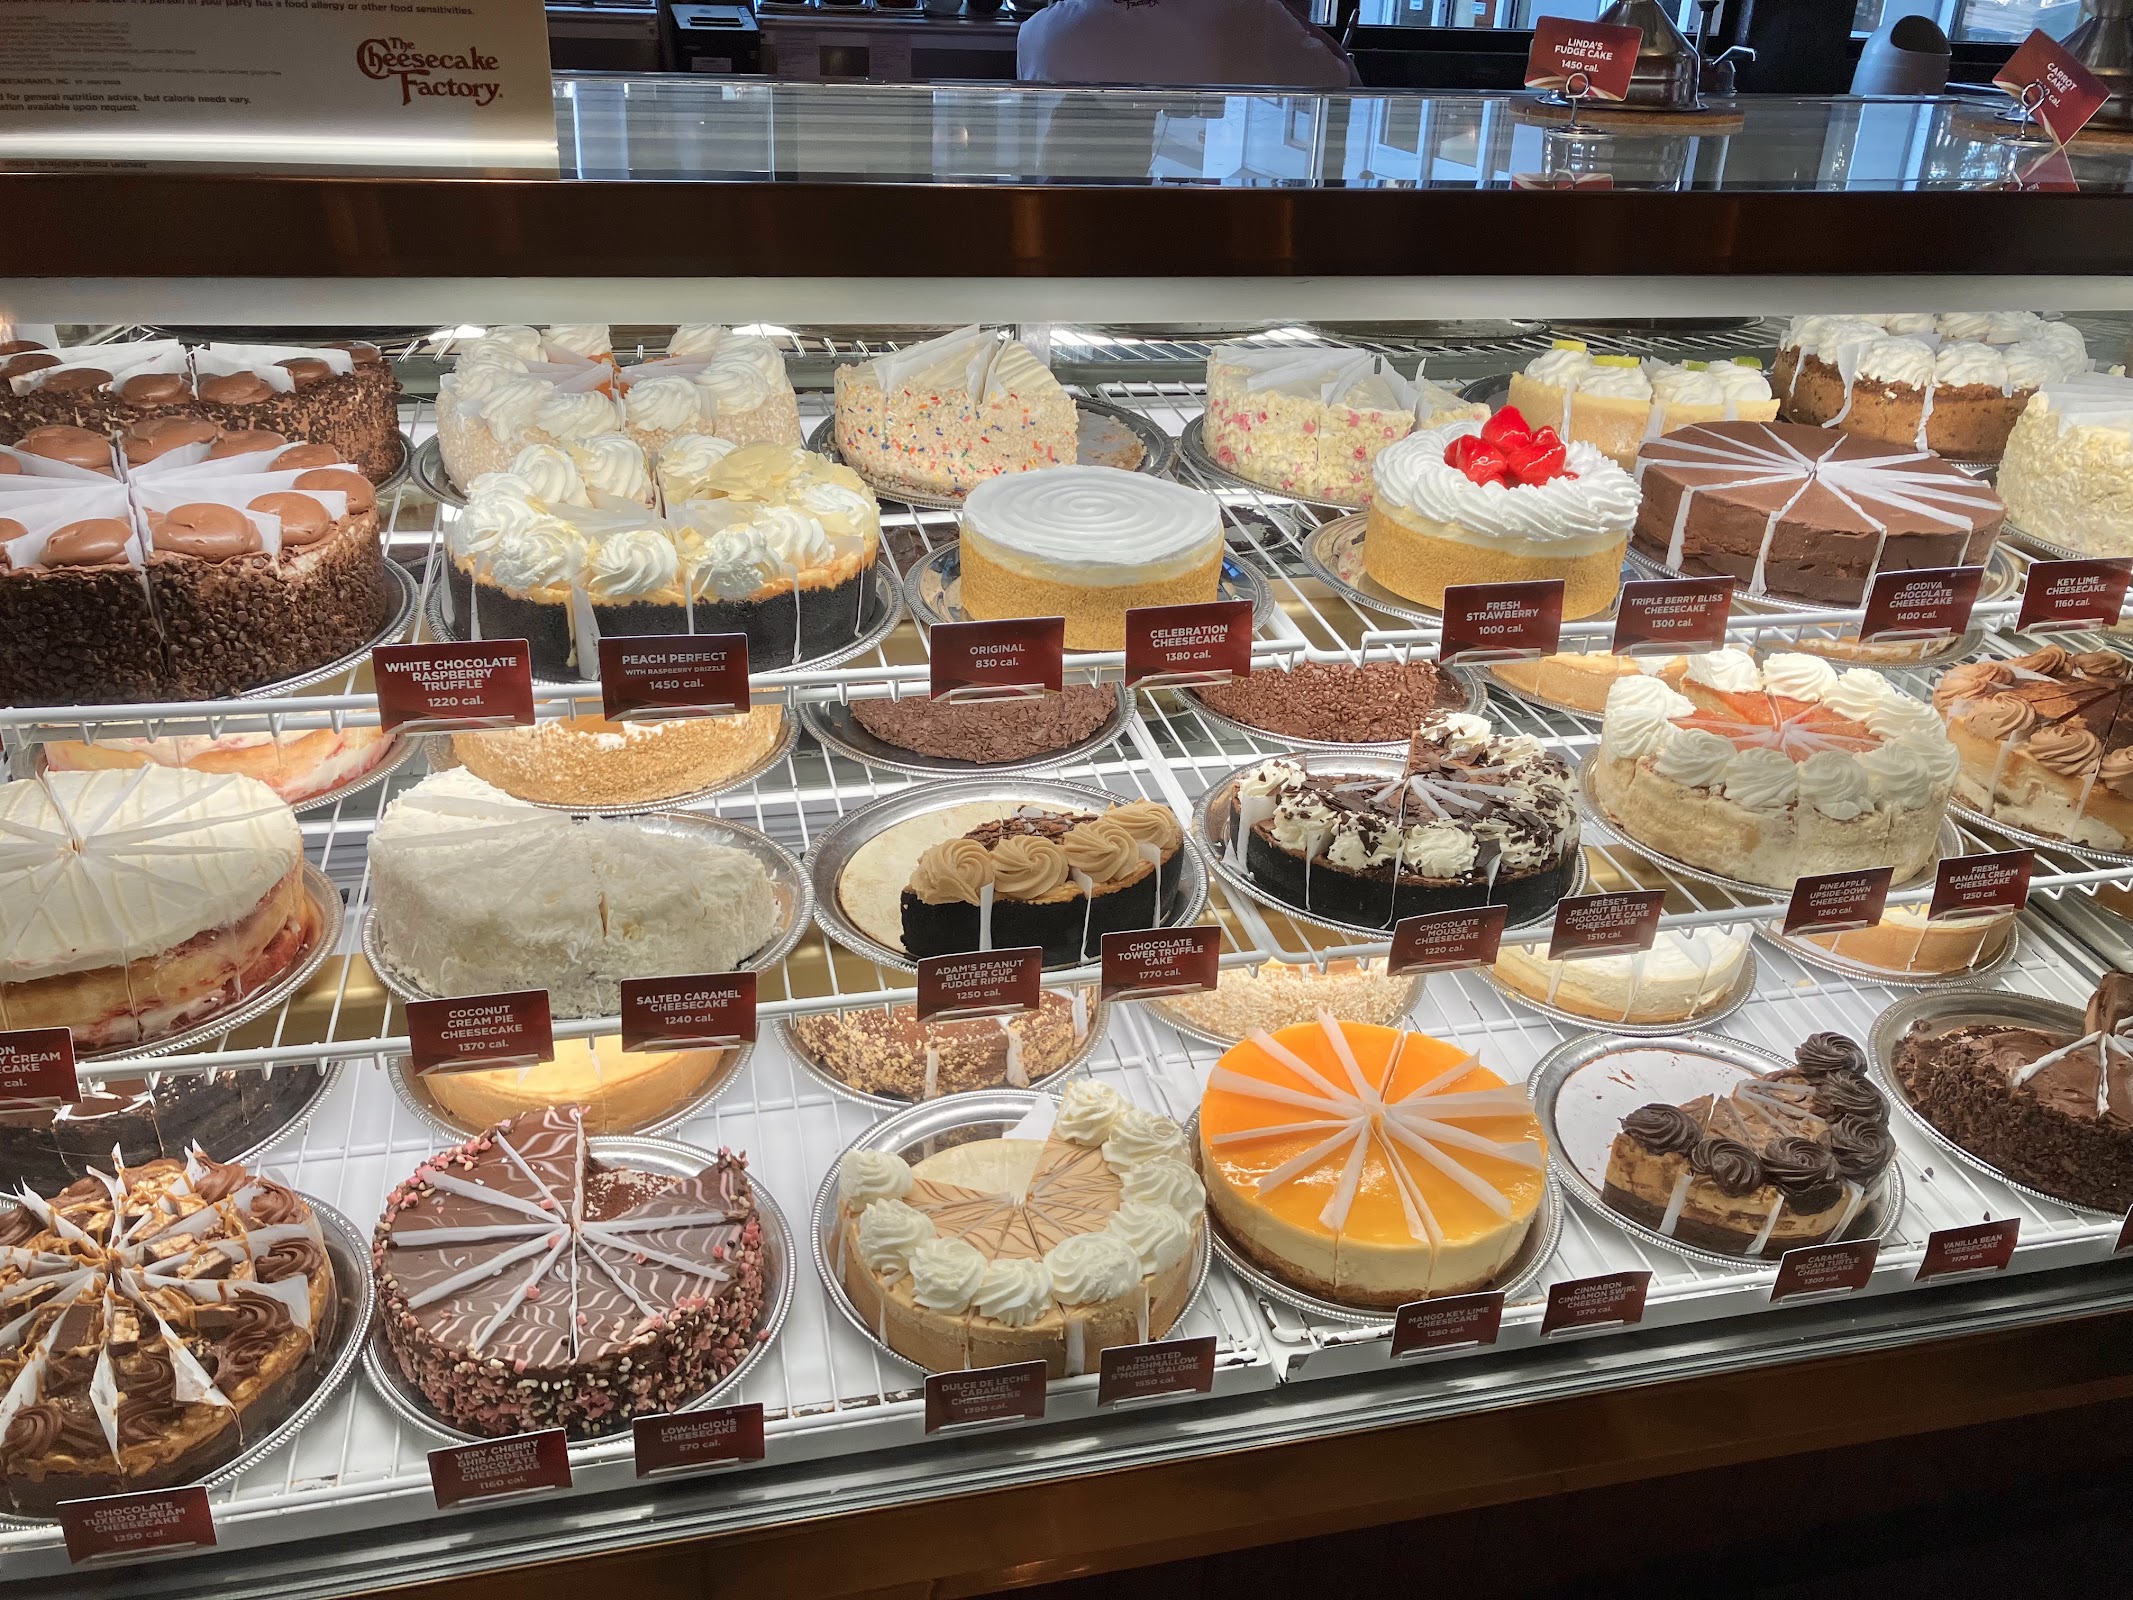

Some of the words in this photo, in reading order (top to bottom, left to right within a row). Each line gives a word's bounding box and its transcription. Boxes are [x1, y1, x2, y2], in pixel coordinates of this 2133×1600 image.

[285, 0, 309, 9] food
[311, 2, 345, 12] allergy
[361, 3, 387, 12] other
[390, 4, 414, 13] food
[416, 6, 475, 16] sensitivities.
[389, 37, 416, 53] The
[1567, 38, 1603, 51] LINDA'S
[357, 38, 500, 79] Cheesecake
[1555, 45, 1586, 57] FUDGE
[1588, 50, 1612, 61] CAKE
[1561, 59, 1582, 69] 1450
[1584, 63, 1599, 72] cal.
[2047, 62, 2077, 91] CARROT
[2046, 73, 2067, 94] CAKE
[24, 94, 60, 102] general
[63, 93, 104, 101] nutrition
[144, 94, 160, 102] but
[163, 94, 195, 103] calorie
[229, 97, 251, 105] vary.
[2048, 94, 2061, 107] cal.
[28, 103, 70, 111] available
[100, 104, 140, 112] request.
[1906, 581, 1943, 591] GODIVA
[2057, 577, 2074, 586] KEY
[2077, 576, 2100, 584] LIME
[1894, 589, 1952, 599] CHOCOLATE
[2046, 584, 2106, 595] CHEESECAKE
[1487, 601, 1521, 610] FRESH
[1631, 597, 1662, 606] TRIPLE
[1664, 595, 1695, 604] BERRY
[1698, 594, 1723, 603] BLISS
[1889, 597, 1953, 608] CHEESECAKE
[2074, 598, 2090, 607] cal.
[1466, 609, 1539, 621] STRAWBERRY
[1644, 604, 1706, 614] CHEESECAKE
[1897, 612, 1919, 621] 1400
[1922, 611, 1937, 619] cal.
[1652, 619, 1676, 628] 1300
[1678, 618, 1693, 627] cal.
[1150, 625, 1228, 639] CELEBRATION
[1479, 626, 1504, 635] 1000
[1507, 624, 1524, 633] cal.
[1153, 634, 1225, 648] CHEESECAKE
[970, 643, 1025, 655] ORIGINAL
[622, 654, 666, 664] PEACH
[670, 652, 727, 663] PERFECT
[1166, 652, 1190, 661] 1380
[1193, 650, 1211, 660] cal.
[386, 661, 431, 673] WHITE
[435, 657, 517, 670] CHOCOLATE
[976, 658, 997, 668] 830
[1000, 657, 1019, 667] cal.
[412, 669, 492, 681] RASPBERRY
[647, 667, 692, 675] RASPBERRY
[694, 665, 726, 673] DRIZZLE
[422, 679, 483, 692] TRUFFLE
[650, 680, 679, 690] 1450
[683, 678, 704, 688] cal.
[427, 697, 458, 707] 1220
[462, 695, 484, 706] cal.
[1971, 864, 1999, 873] FRESH
[1950, 873, 1986, 884] BANANA
[1989, 869, 2018, 879] CREAM
[1819, 879, 1866, 890] PINEAPPLE
[1955, 877, 2011, 890] CHEESECAKE
[1810, 886, 1871, 899] UPSIDE-DOWN
[1962, 891, 1981, 900] 1250
[1983, 889, 1997, 898] cal.
[1590, 897, 1628, 907] REESE'S
[1810, 894, 1867, 907] CHEESECAKE
[1570, 906, 1608, 917] PEANUT
[1611, 903, 1647, 913] BUTTER
[1818, 908, 1837, 916] 1260
[1839, 906, 1853, 915] cal.
[1566, 913, 1621, 925] CHOCOLATE
[1624, 910, 1649, 919] CAKE
[1420, 919, 1479, 932] CHOCOLATE
[1575, 918, 1636, 931] CHEESECAKE
[1415, 932, 1479, 945] CHEESECAKE
[1428, 927, 1468, 938] MOUSSE
[1587, 932, 1605, 941] 1510
[1607, 930, 1622, 940] cal.
[1129, 938, 1192, 952] CHOCOLATE
[1425, 946, 1446, 955] 1220
[1449, 945, 1464, 953] cal.
[1118, 950, 1156, 961] TOWER
[1159, 945, 1203, 957] TRUFFLE
[935, 964, 977, 975] ADAM'S
[980, 960, 1024, 970] PEANUT
[1145, 957, 1173, 966] CAKE
[946, 971, 988, 981] BUTTER
[991, 969, 1013, 977] CUP
[1139, 970, 1162, 979] 1770
[1165, 968, 1181, 977] cal.
[941, 978, 977, 990] FUDGE
[980, 976, 1017, 985] RIPPLE
[636, 993, 681, 1005] SALTED
[685, 990, 741, 1002] CARAMEL
[957, 991, 981, 1000] 1250
[983, 989, 1001, 998] cal.
[449, 1005, 510, 1018] COCONUT
[651, 1000, 728, 1012] CHEESECAKE
[448, 1017, 491, 1028] CREAM
[495, 1015, 514, 1024] PIE
[665, 1015, 691, 1025] 1240
[695, 1013, 714, 1023] cal.
[441, 1024, 523, 1040] CHEESECAKE
[458, 1041, 485, 1051] 1370
[489, 1040, 509, 1049] cal.
[11, 1052, 61, 1063] CREAM
[1943, 1238, 1978, 1249] VANILLA
[1980, 1234, 2002, 1244] BEAN
[1945, 1241, 1998, 1255] CHEESECAKE
[1409, 1313, 1444, 1324] MANGO
[1447, 1309, 1466, 1319] KEY
[1468, 1306, 1489, 1316] LIME
[1417, 1314, 1479, 1328] CHEESECAKE
[1427, 1327, 1447, 1336] 1280
[661, 1418, 737, 1436] LOW-LICIOUS
[662, 1426, 737, 1442] CHEESECAKE
[680, 1442, 699, 1451] 570
